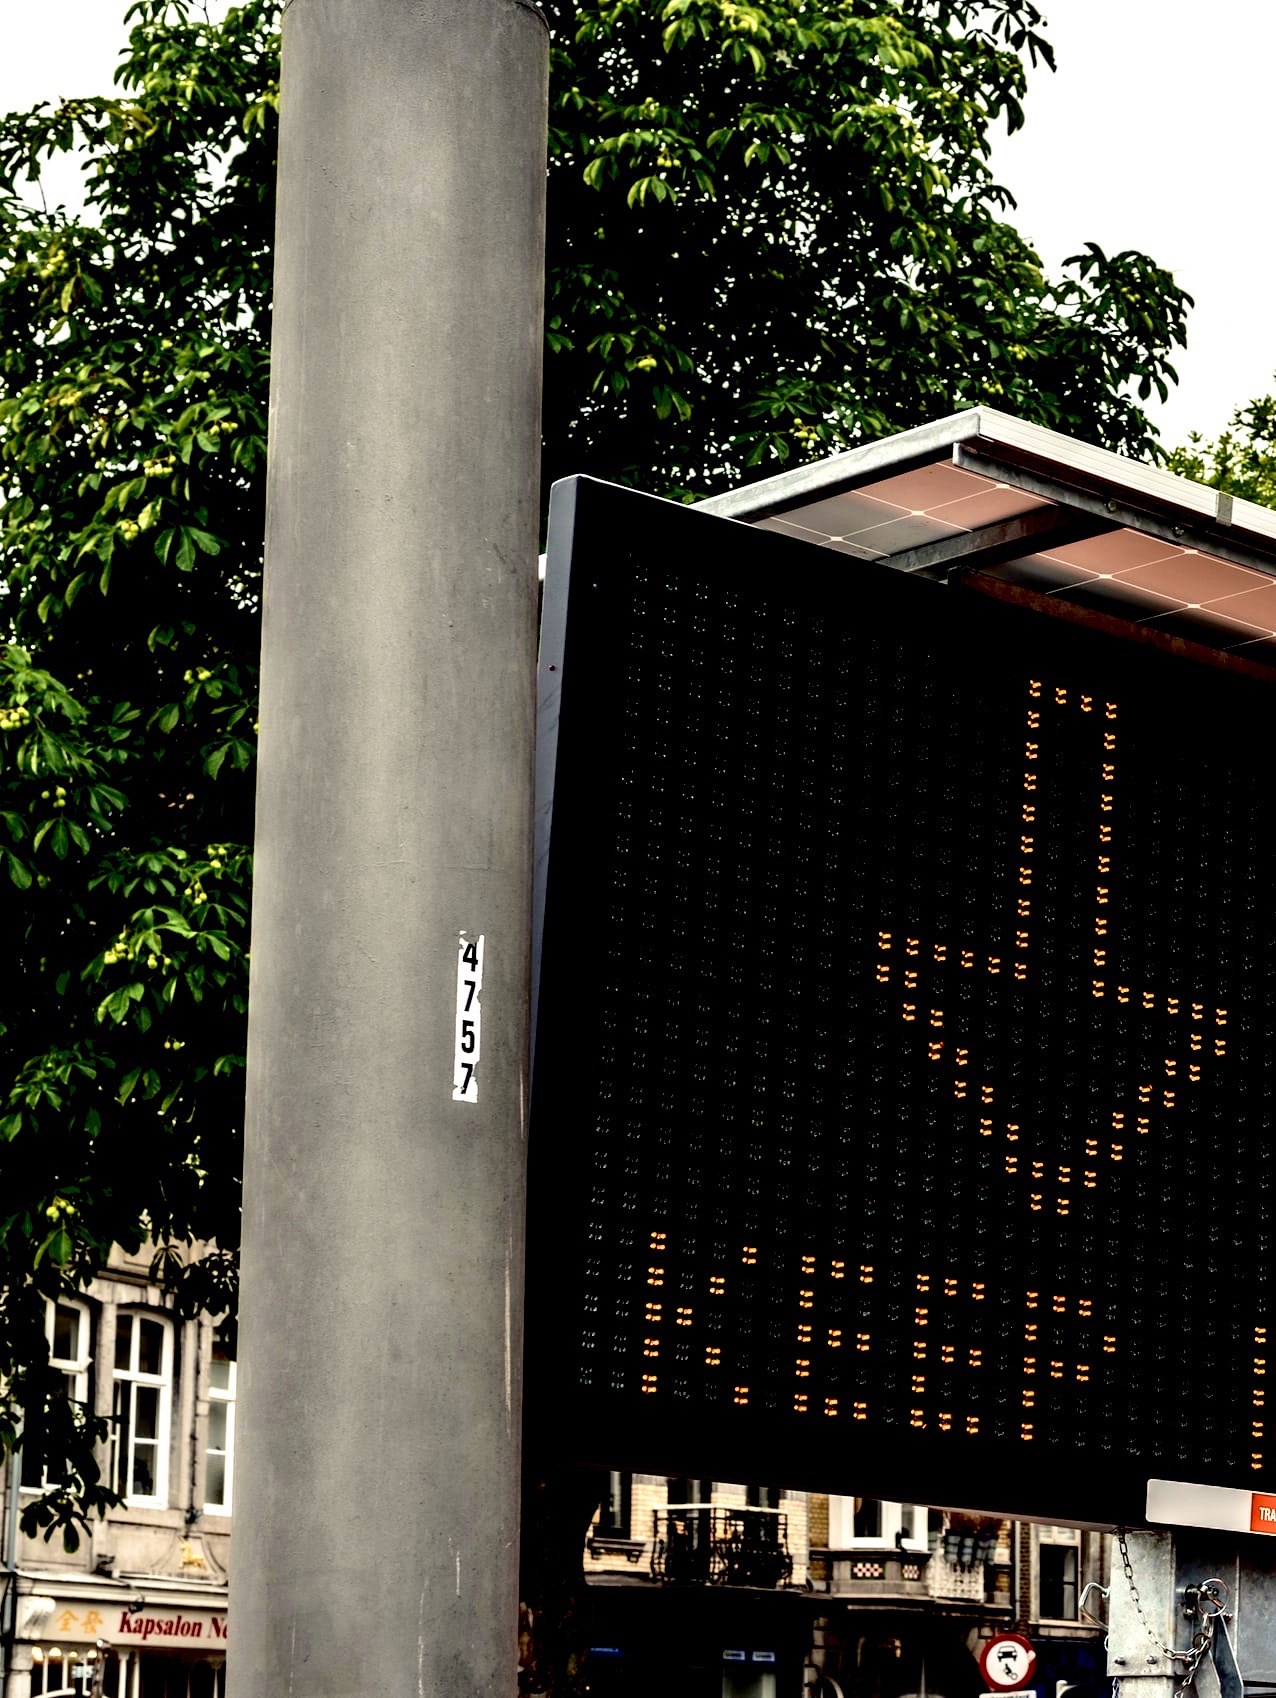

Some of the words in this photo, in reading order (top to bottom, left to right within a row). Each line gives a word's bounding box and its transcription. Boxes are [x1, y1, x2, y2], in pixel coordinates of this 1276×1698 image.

[460, 942, 479, 1095] 4757
[640, 1231, 1118, 1442] KEEP
[118, 1611, 203, 1640] Kapsalon
